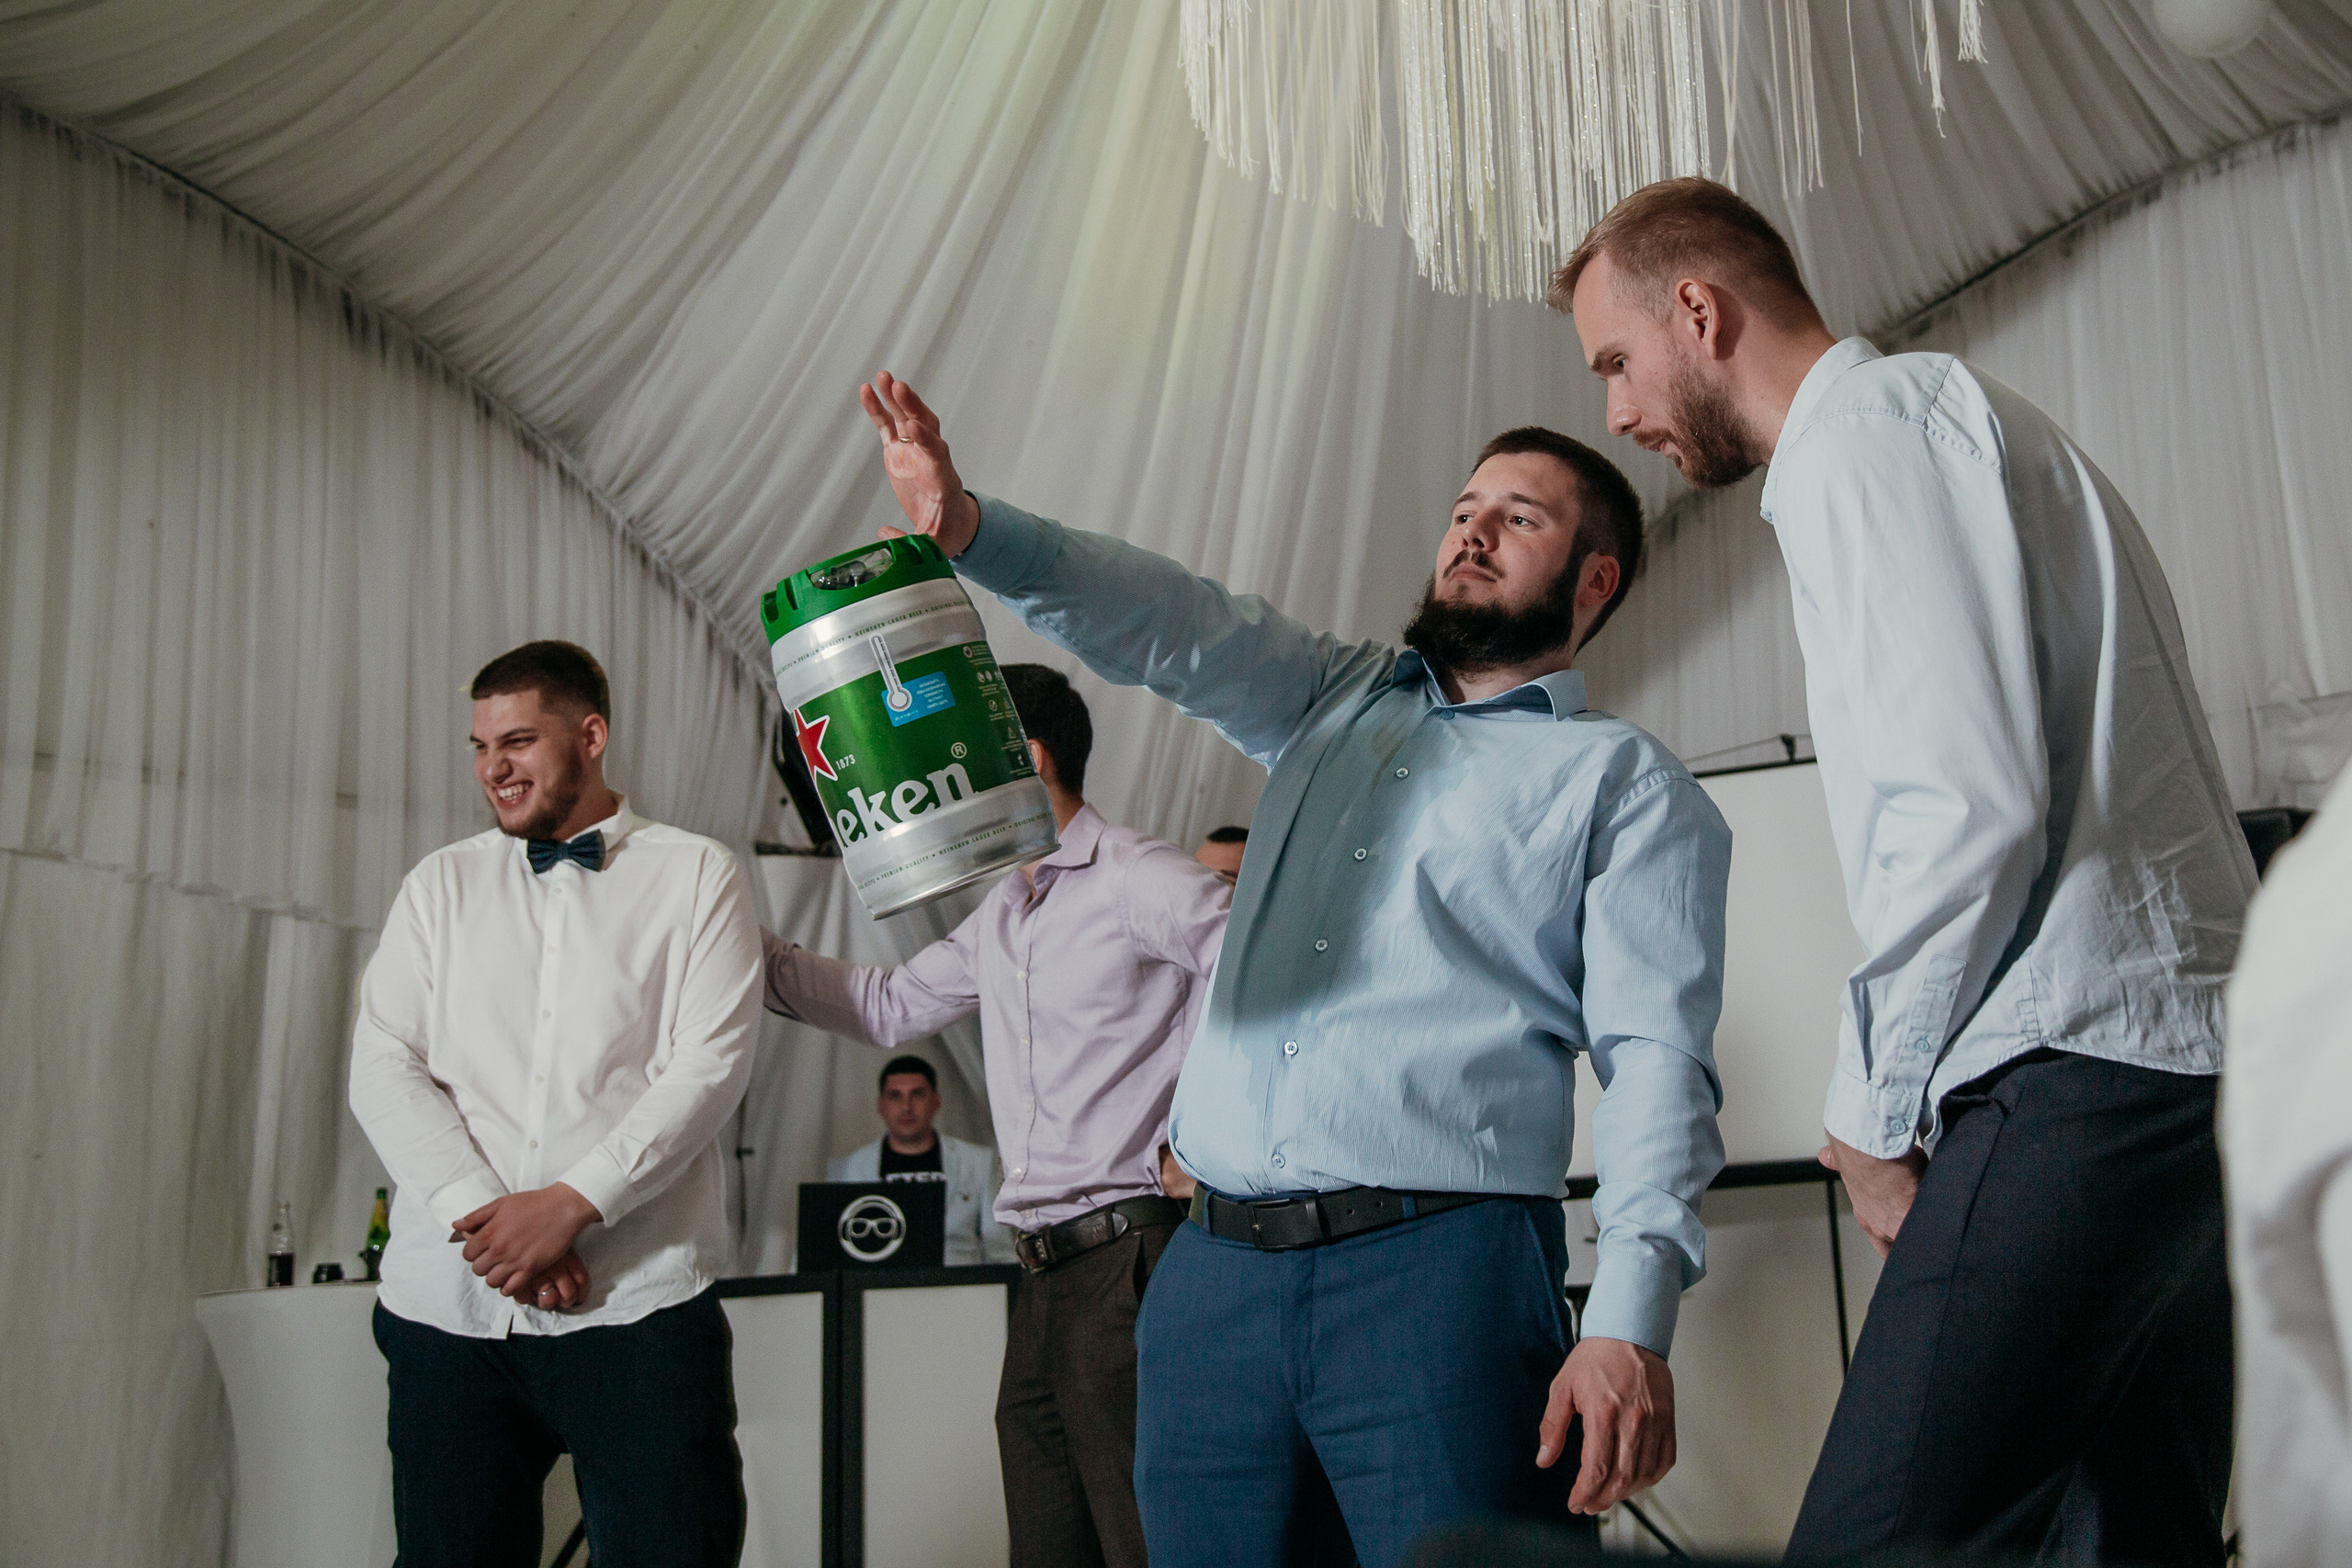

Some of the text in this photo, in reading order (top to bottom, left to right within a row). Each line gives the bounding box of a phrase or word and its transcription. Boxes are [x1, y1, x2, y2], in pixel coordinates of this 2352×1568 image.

[797, 649, 820, 661] PREMIUM
[854, 622, 886, 637] HEINEKEN
[888, 615, 907, 625] LAGER
[908, 610, 922, 618] BEER
[835, 753, 856, 771] 1873
[831, 762, 979, 849] eken
[881, 866, 903, 879] PREMIUM
[905, 855, 930, 869] QUALITY
[938, 840, 970, 855] HEINEKEN
[971, 831, 990, 842] LAGER
[992, 826, 1006, 835] BEER
